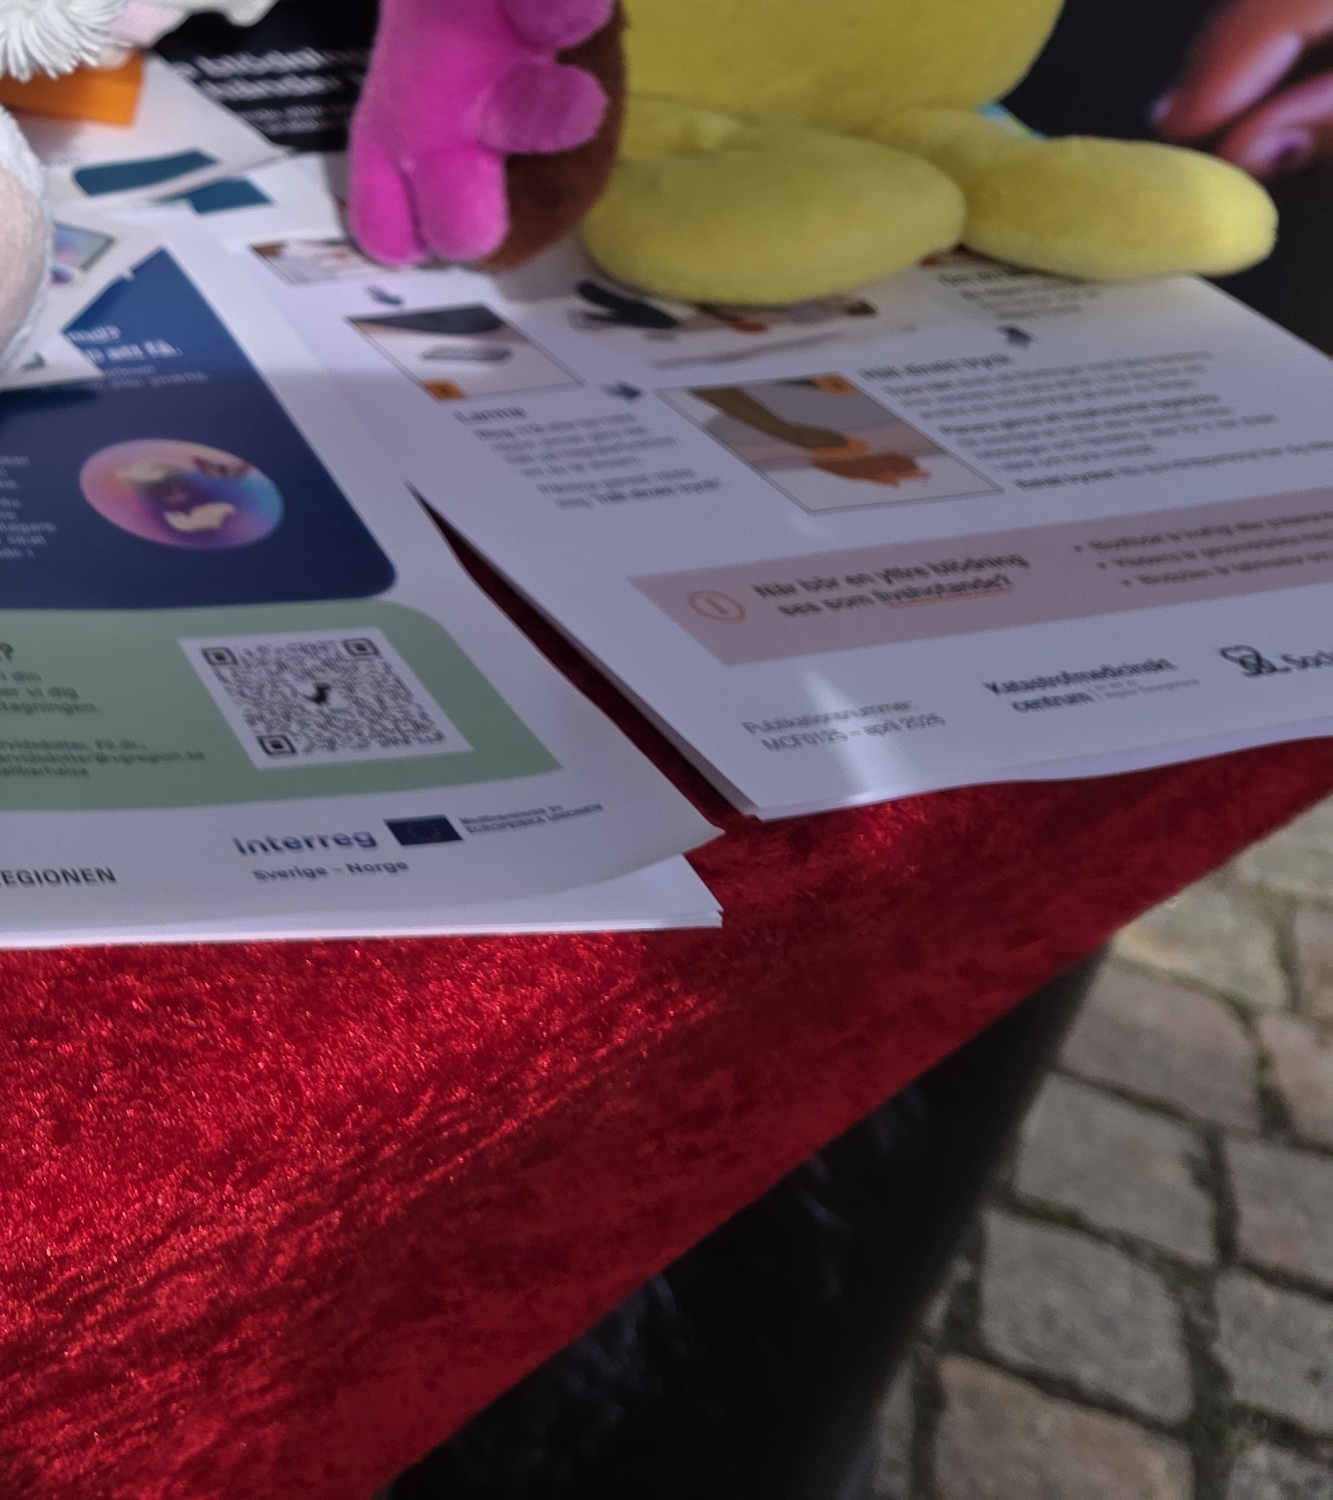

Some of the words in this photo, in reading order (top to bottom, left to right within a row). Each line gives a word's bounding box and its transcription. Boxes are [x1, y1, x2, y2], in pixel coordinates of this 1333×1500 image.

[11, 670, 44, 684] din
[1010, 691, 1097, 714] centrum
[233, 830, 379, 857] Interreg
[251, 864, 329, 882] Sverige
[345, 861, 410, 875] Norge
